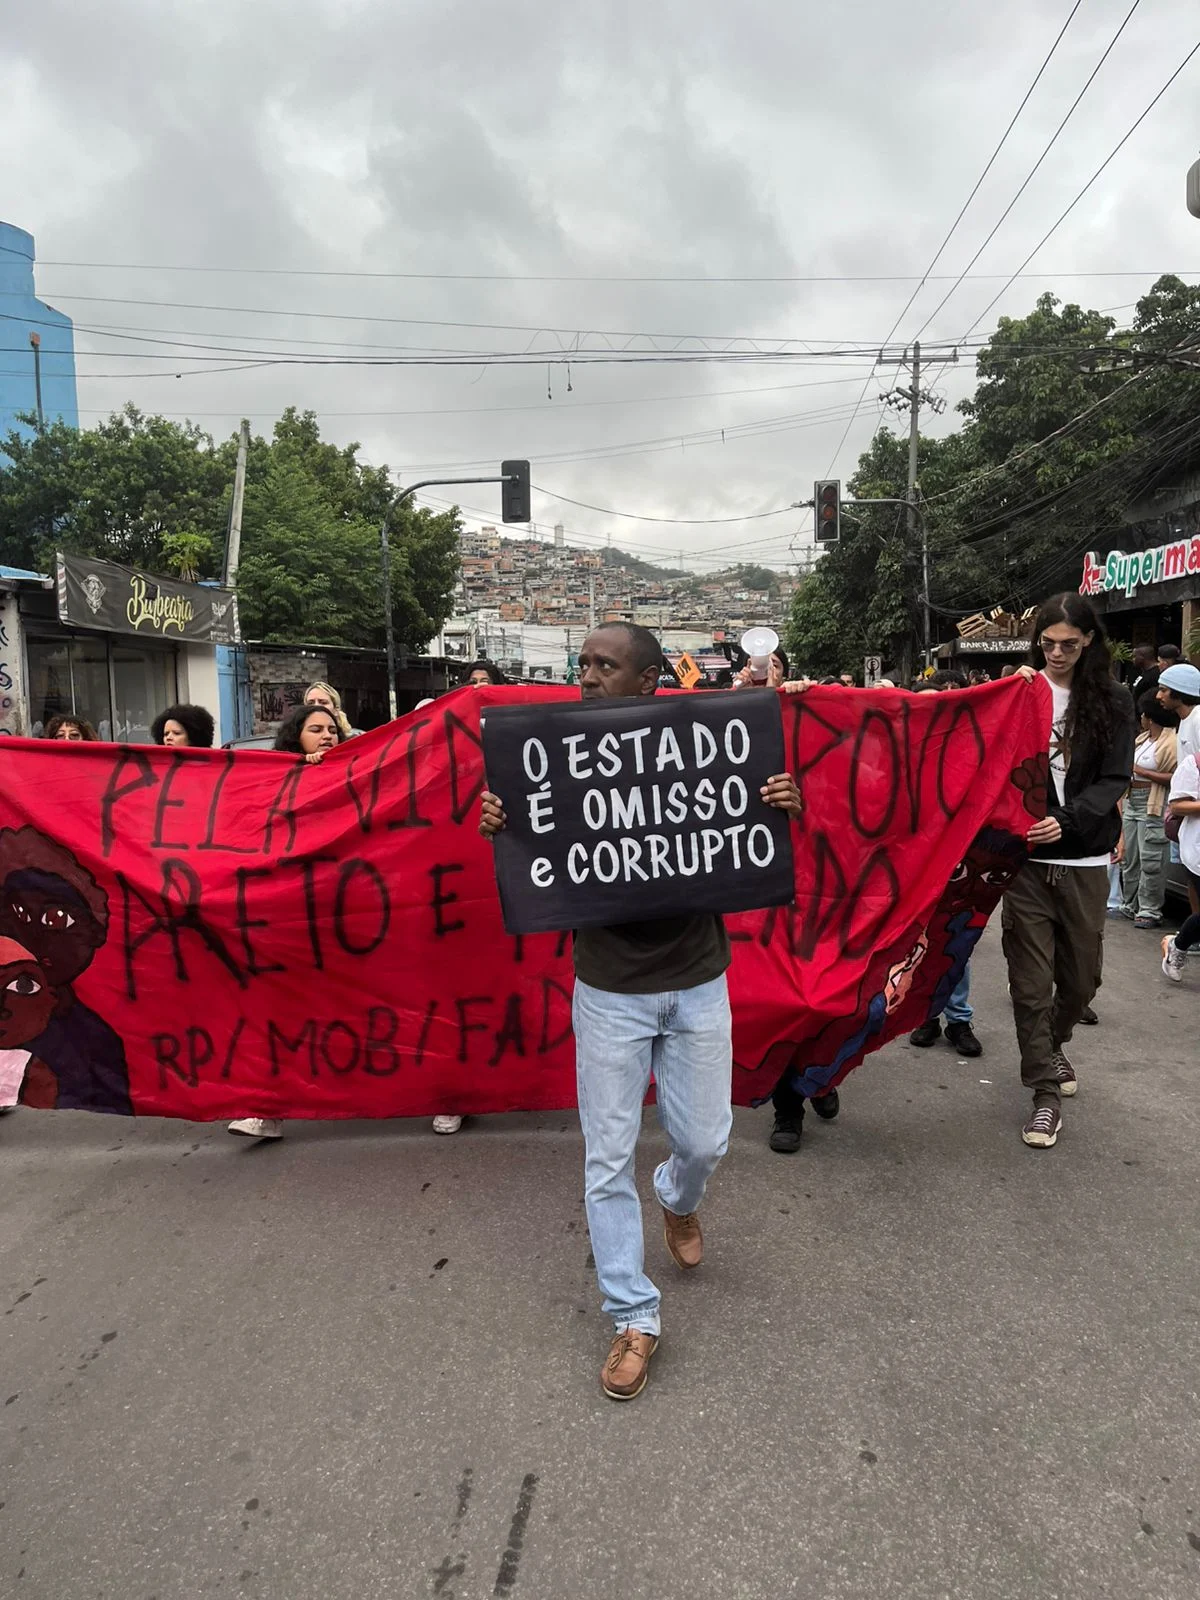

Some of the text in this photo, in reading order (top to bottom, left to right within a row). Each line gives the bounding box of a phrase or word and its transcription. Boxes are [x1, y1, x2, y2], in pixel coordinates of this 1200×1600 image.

[1104, 535, 1200, 597] Superma
[101, 745, 306, 857] PELA
[793, 697, 985, 838] POVO
[522, 718, 750, 783] O ESTADO
[526, 775, 748, 833] É OMISSO
[530, 823, 775, 887] e CORRUPTO
[430, 864, 466, 936] E
